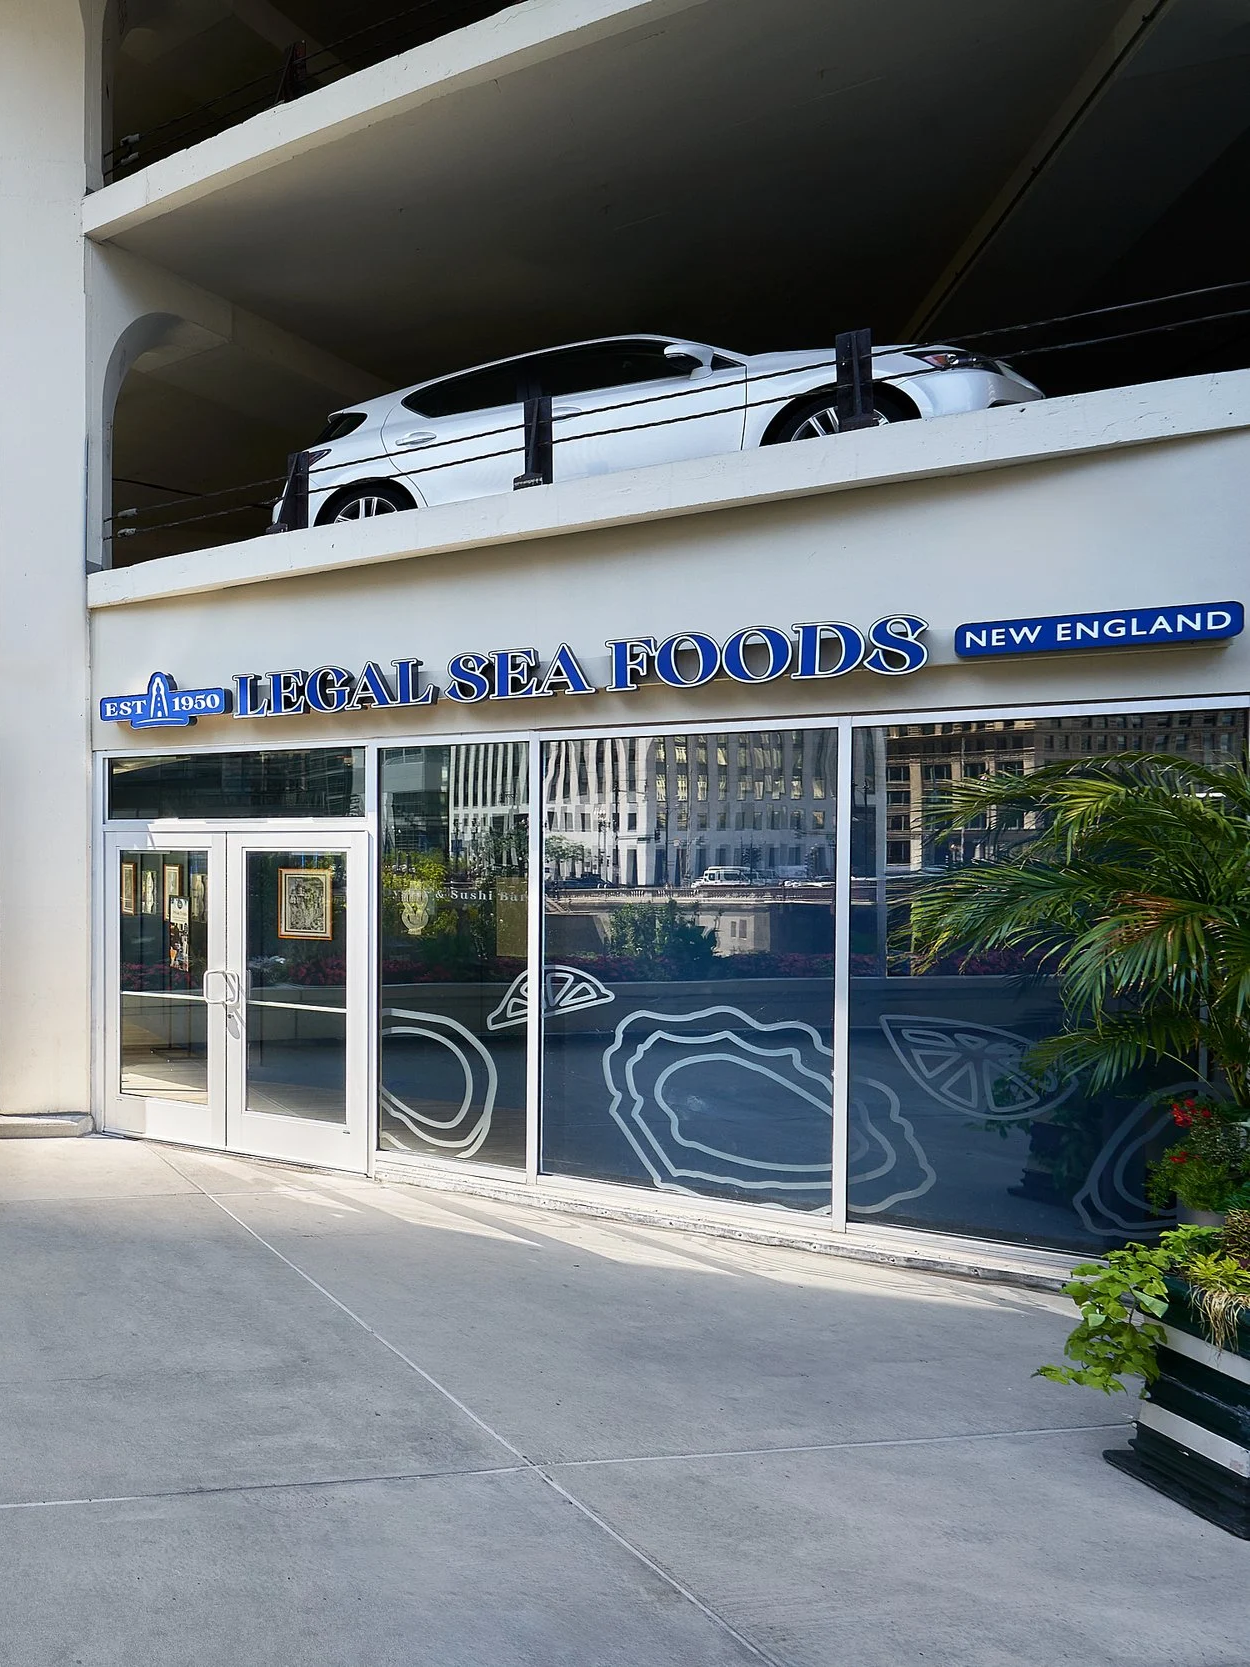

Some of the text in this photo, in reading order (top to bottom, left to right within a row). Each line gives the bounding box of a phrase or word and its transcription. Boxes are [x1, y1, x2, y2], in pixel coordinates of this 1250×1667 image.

[965, 610, 1233, 648] NEW ENGLAND
[233, 613, 930, 719] LEGAL SEA FOODS
[105, 692, 221, 718] EST 1950
[435, 889, 445, 899] &
[450, 890, 493, 900] Sushi
